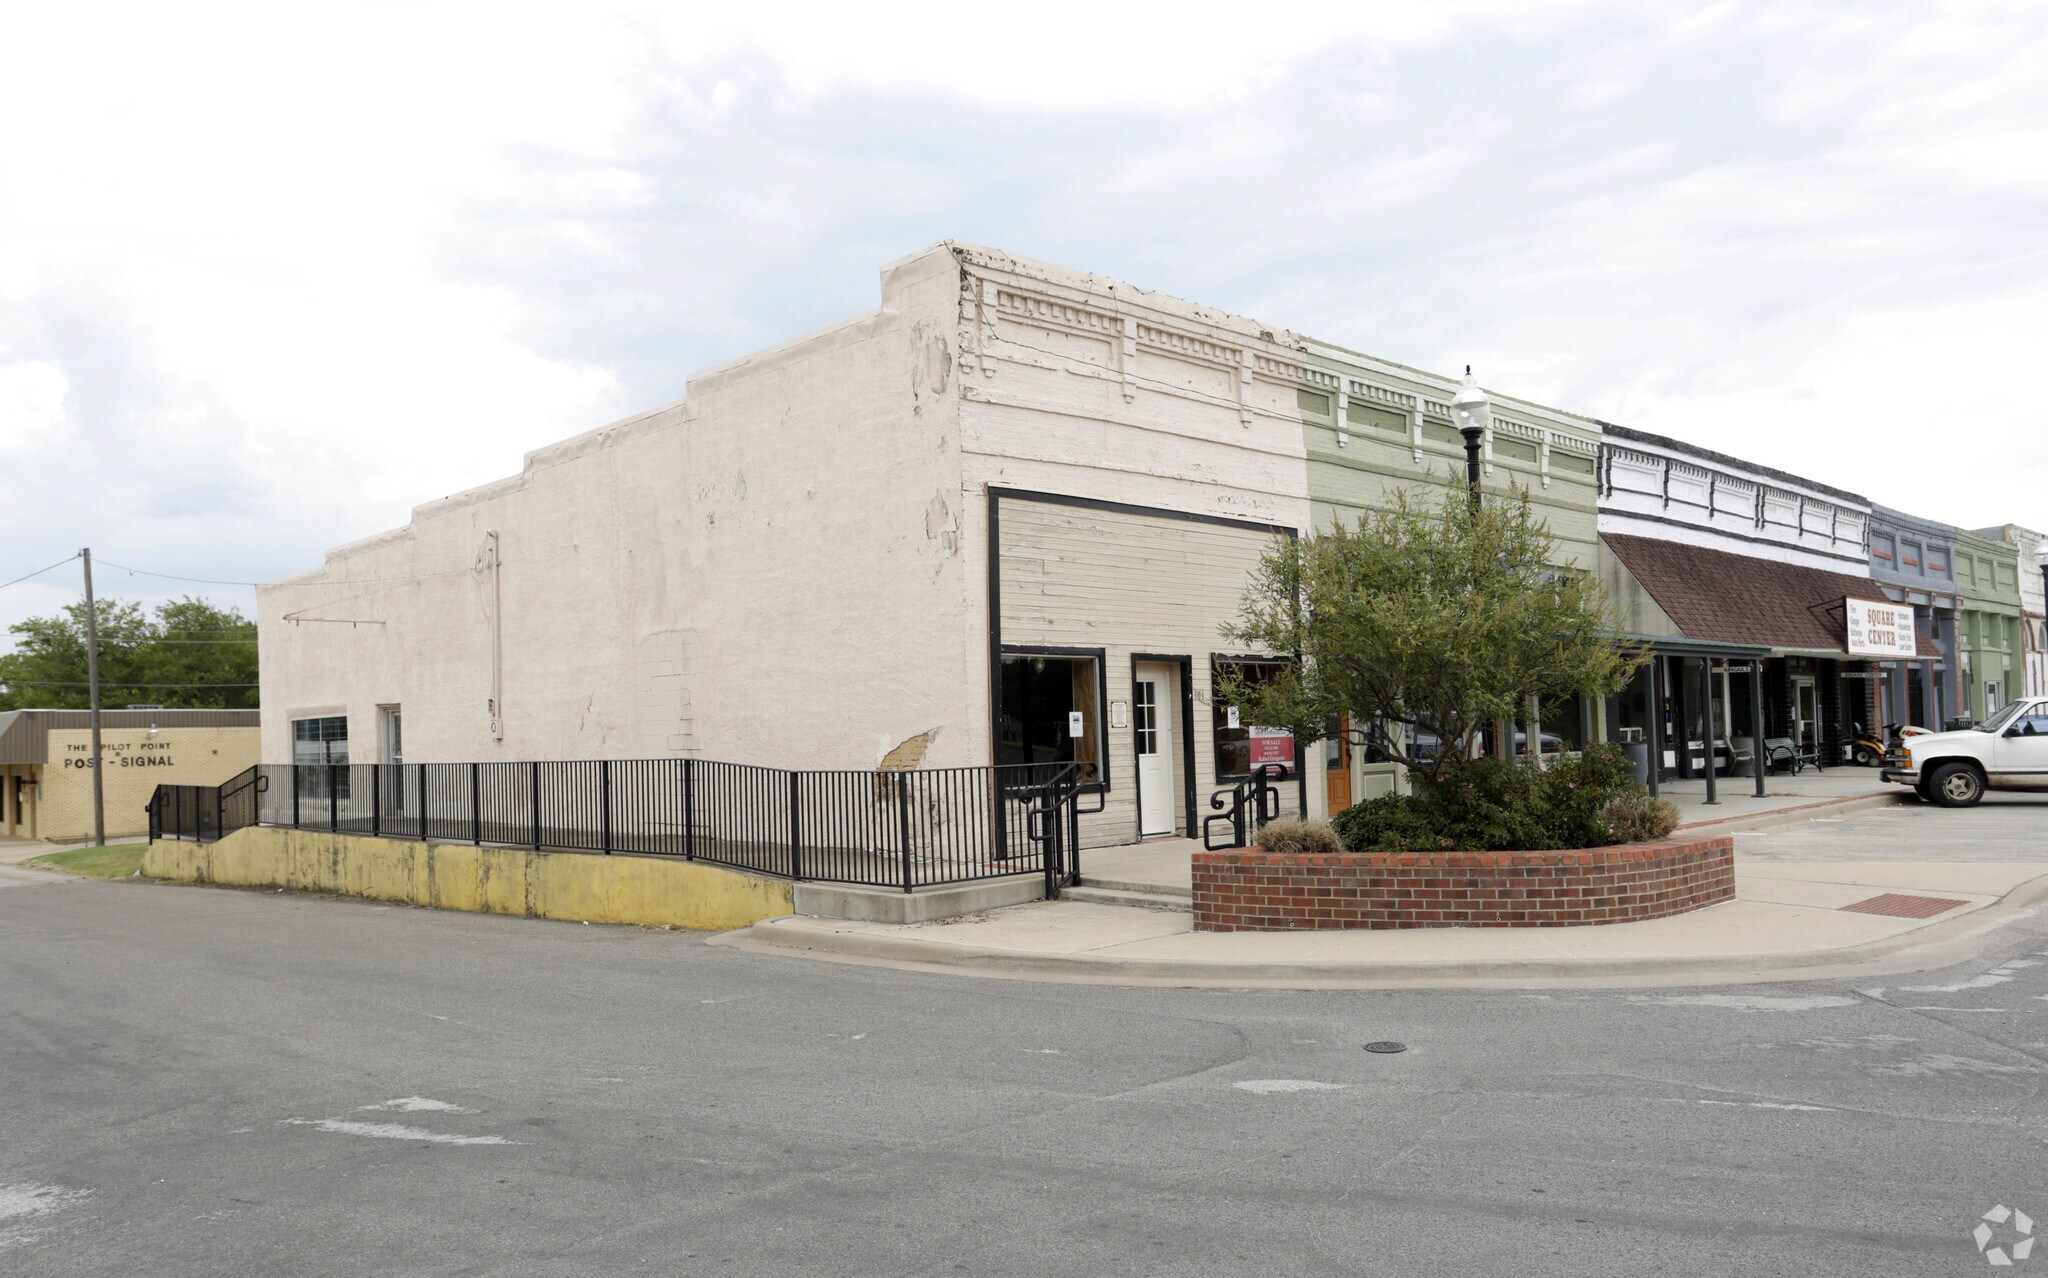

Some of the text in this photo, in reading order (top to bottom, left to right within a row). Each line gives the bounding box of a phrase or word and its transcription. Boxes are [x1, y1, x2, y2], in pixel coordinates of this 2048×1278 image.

[1867, 608, 1895, 627] SQUARE
[1868, 628, 1896, 646] CENTER
[100, 743, 131, 751] PILOT
[120, 756, 174, 767] SIGNAL
